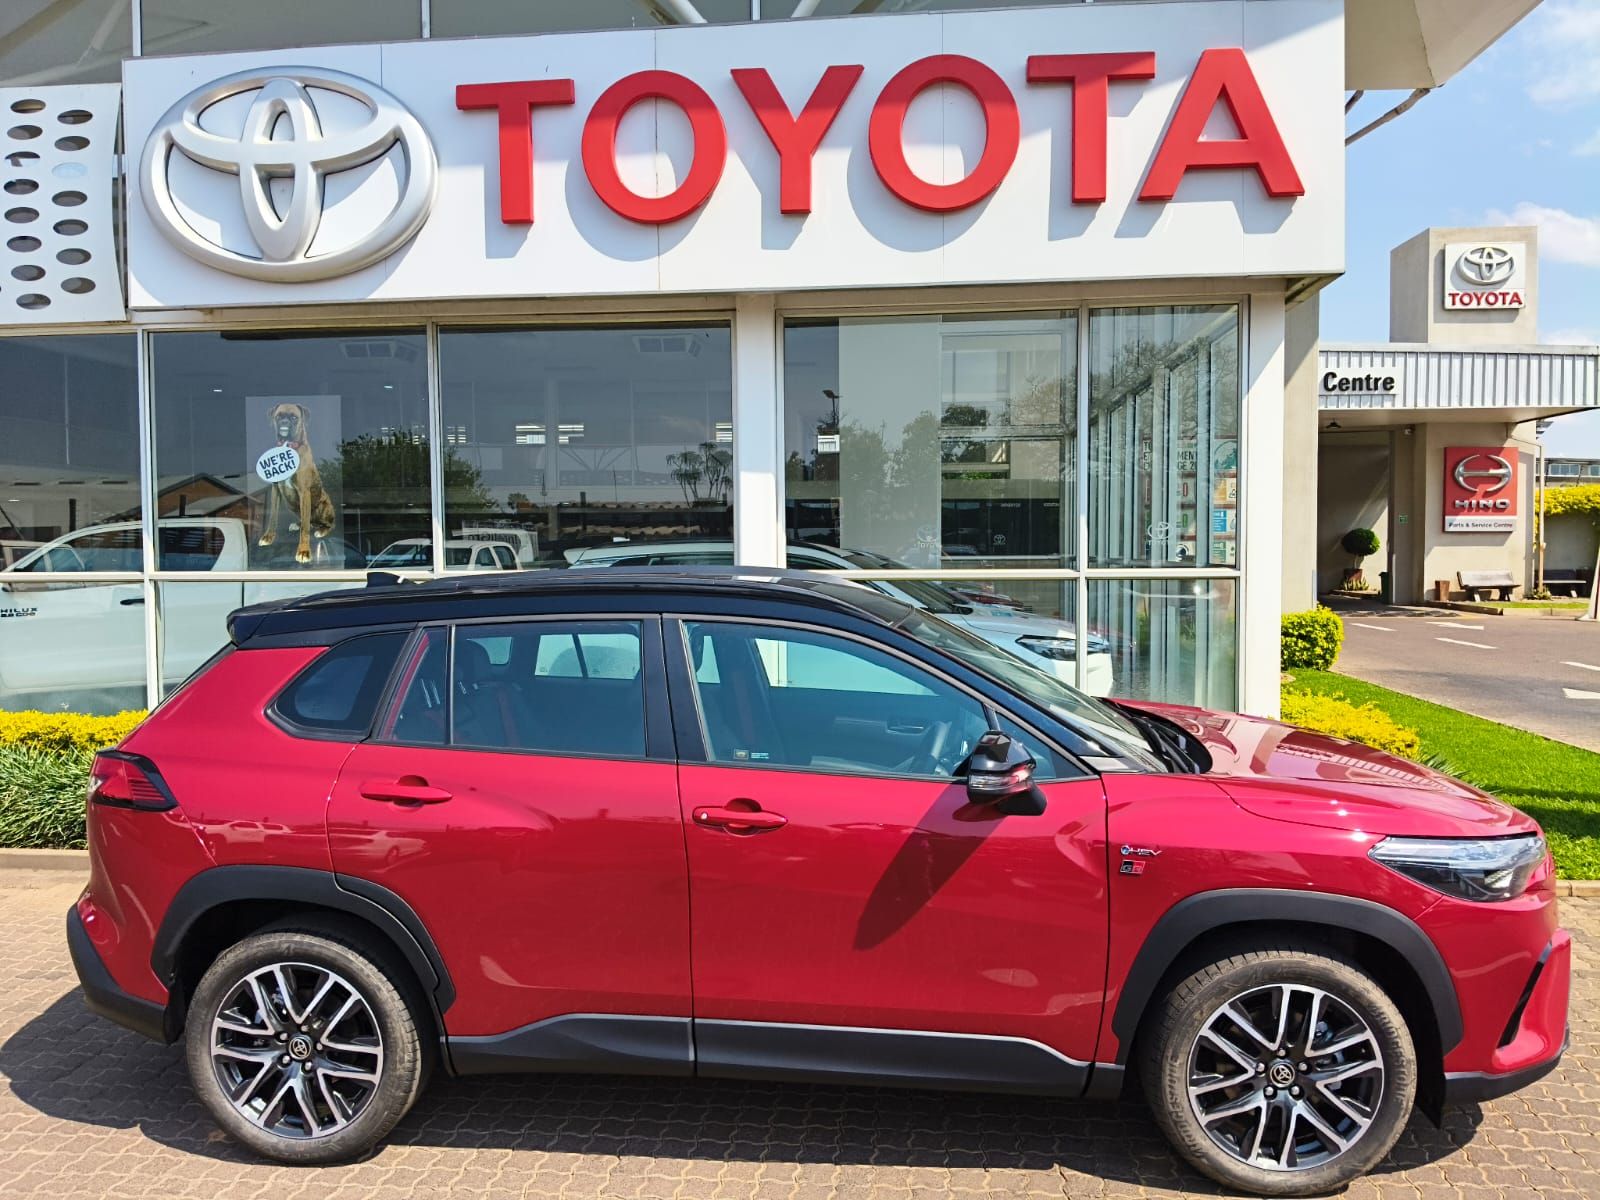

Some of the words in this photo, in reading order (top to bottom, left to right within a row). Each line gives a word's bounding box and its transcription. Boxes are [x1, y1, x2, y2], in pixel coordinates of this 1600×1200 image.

[456, 48, 1305, 224] TOYOTA
[1448, 291, 1523, 307] TOYOTA
[1323, 371, 1395, 393] Centre
[260, 449, 294, 470] WE'RE
[264, 459, 296, 479] BACK!
[1455, 498, 1511, 509] HINO
